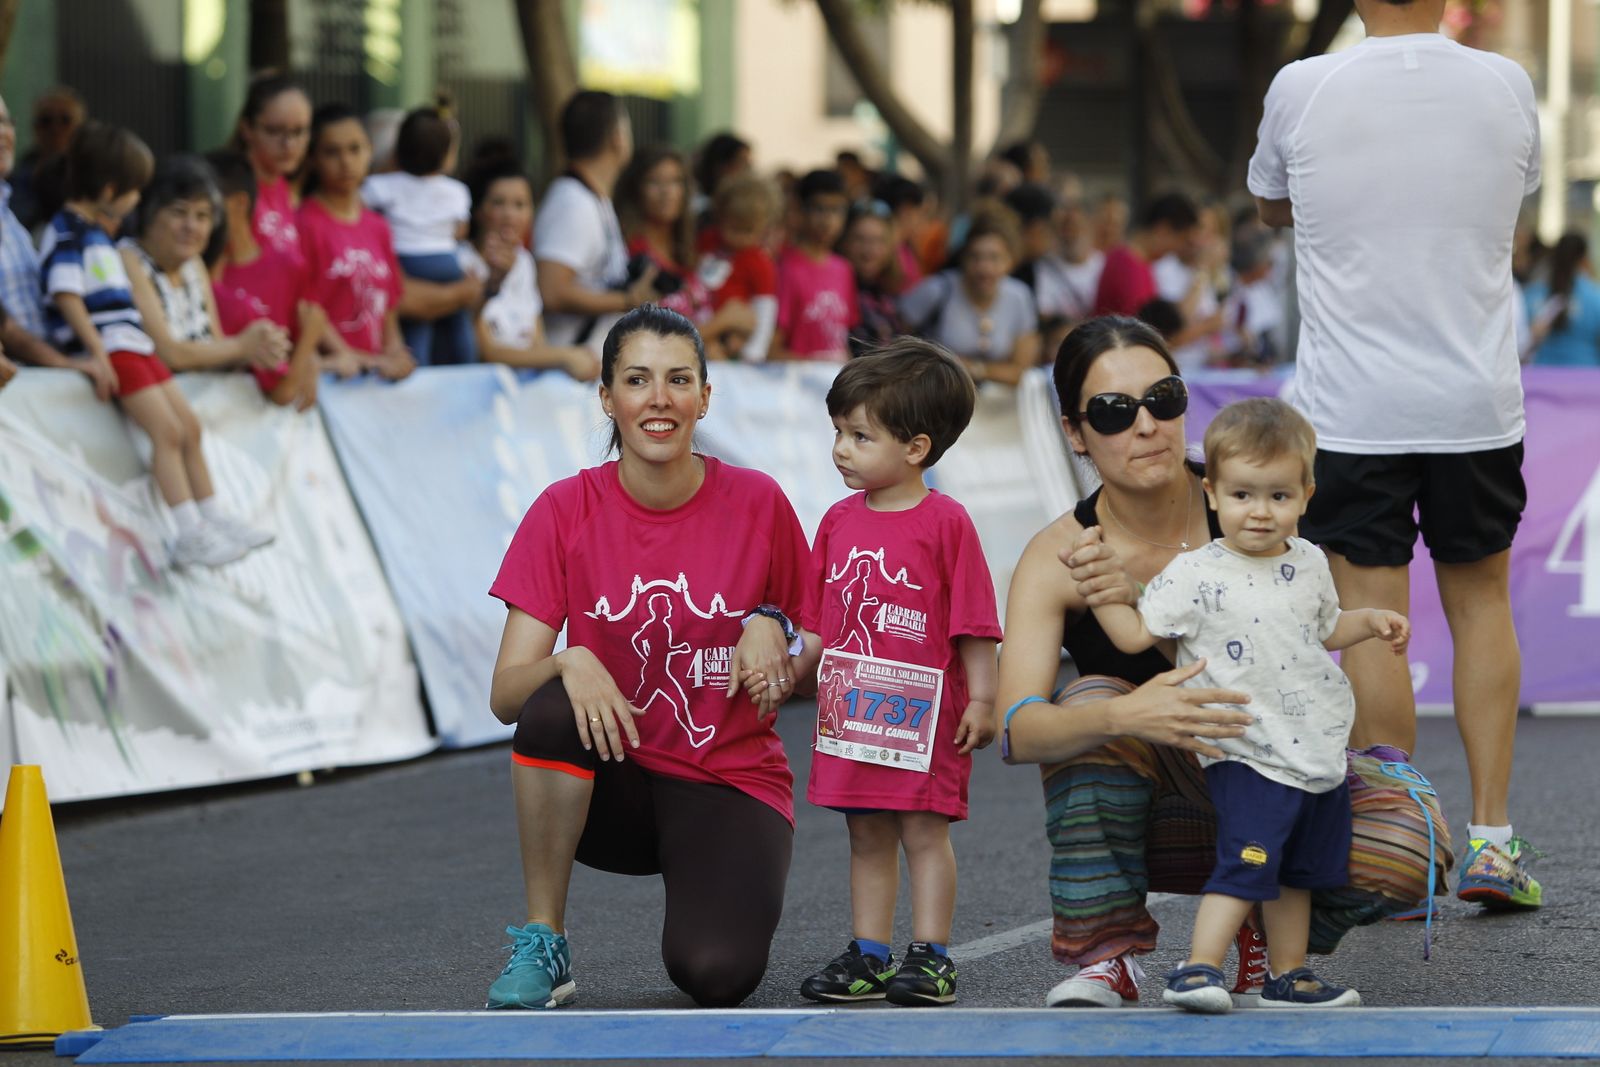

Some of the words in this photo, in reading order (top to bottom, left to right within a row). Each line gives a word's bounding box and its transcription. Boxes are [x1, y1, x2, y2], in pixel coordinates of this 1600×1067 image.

[872, 603, 888, 632] 4
[886, 614, 926, 632] SOLIDARIA
[888, 603, 927, 623] CARRERA
[704, 646, 737, 661] CARR
[686, 648, 707, 688] 4
[854, 661, 861, 679] 4
[861, 662, 896, 677] CARRERA
[898, 669, 936, 684] SOLIDARIA
[844, 688, 932, 728] 1737
[842, 720, 883, 736] PATRULLA
[885, 726, 920, 741] CANINA
